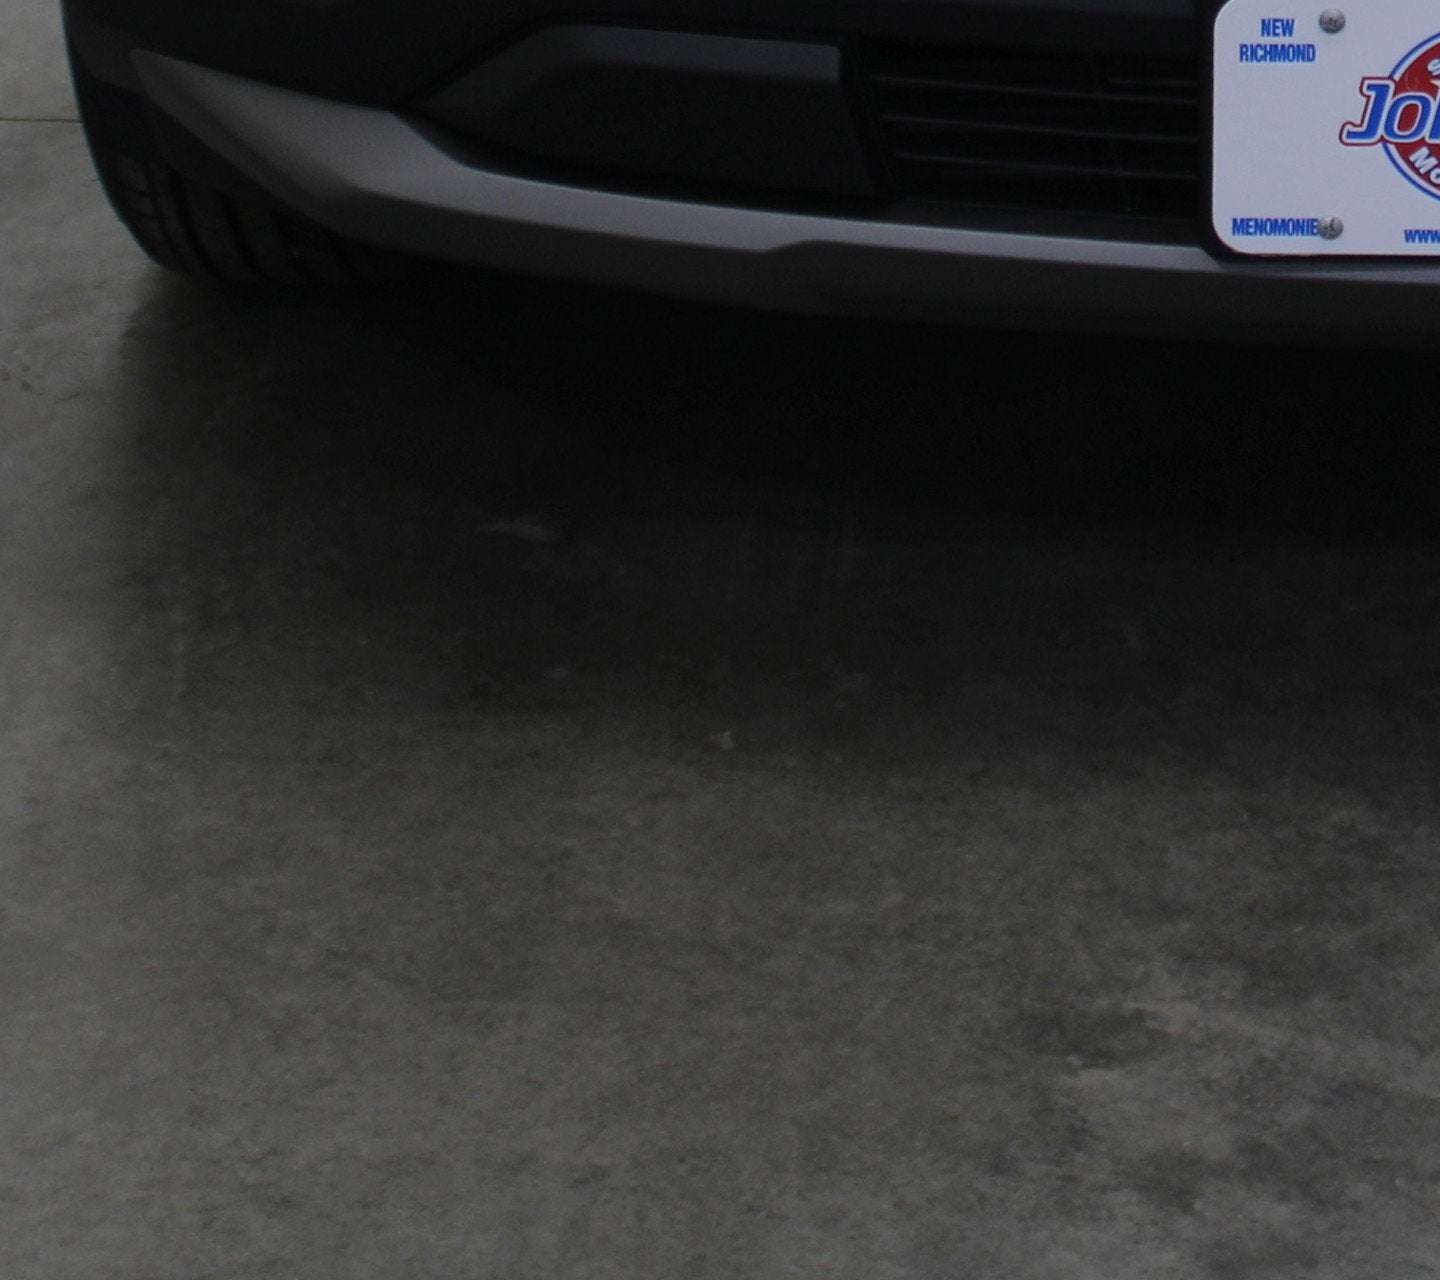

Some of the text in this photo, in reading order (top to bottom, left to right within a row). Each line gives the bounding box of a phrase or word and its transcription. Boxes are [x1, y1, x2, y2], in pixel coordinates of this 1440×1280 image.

[1261, 18, 1295, 37] NEW
[1239, 44, 1316, 63] RICHMOND
[1232, 217, 1319, 236] MENOMONIE
